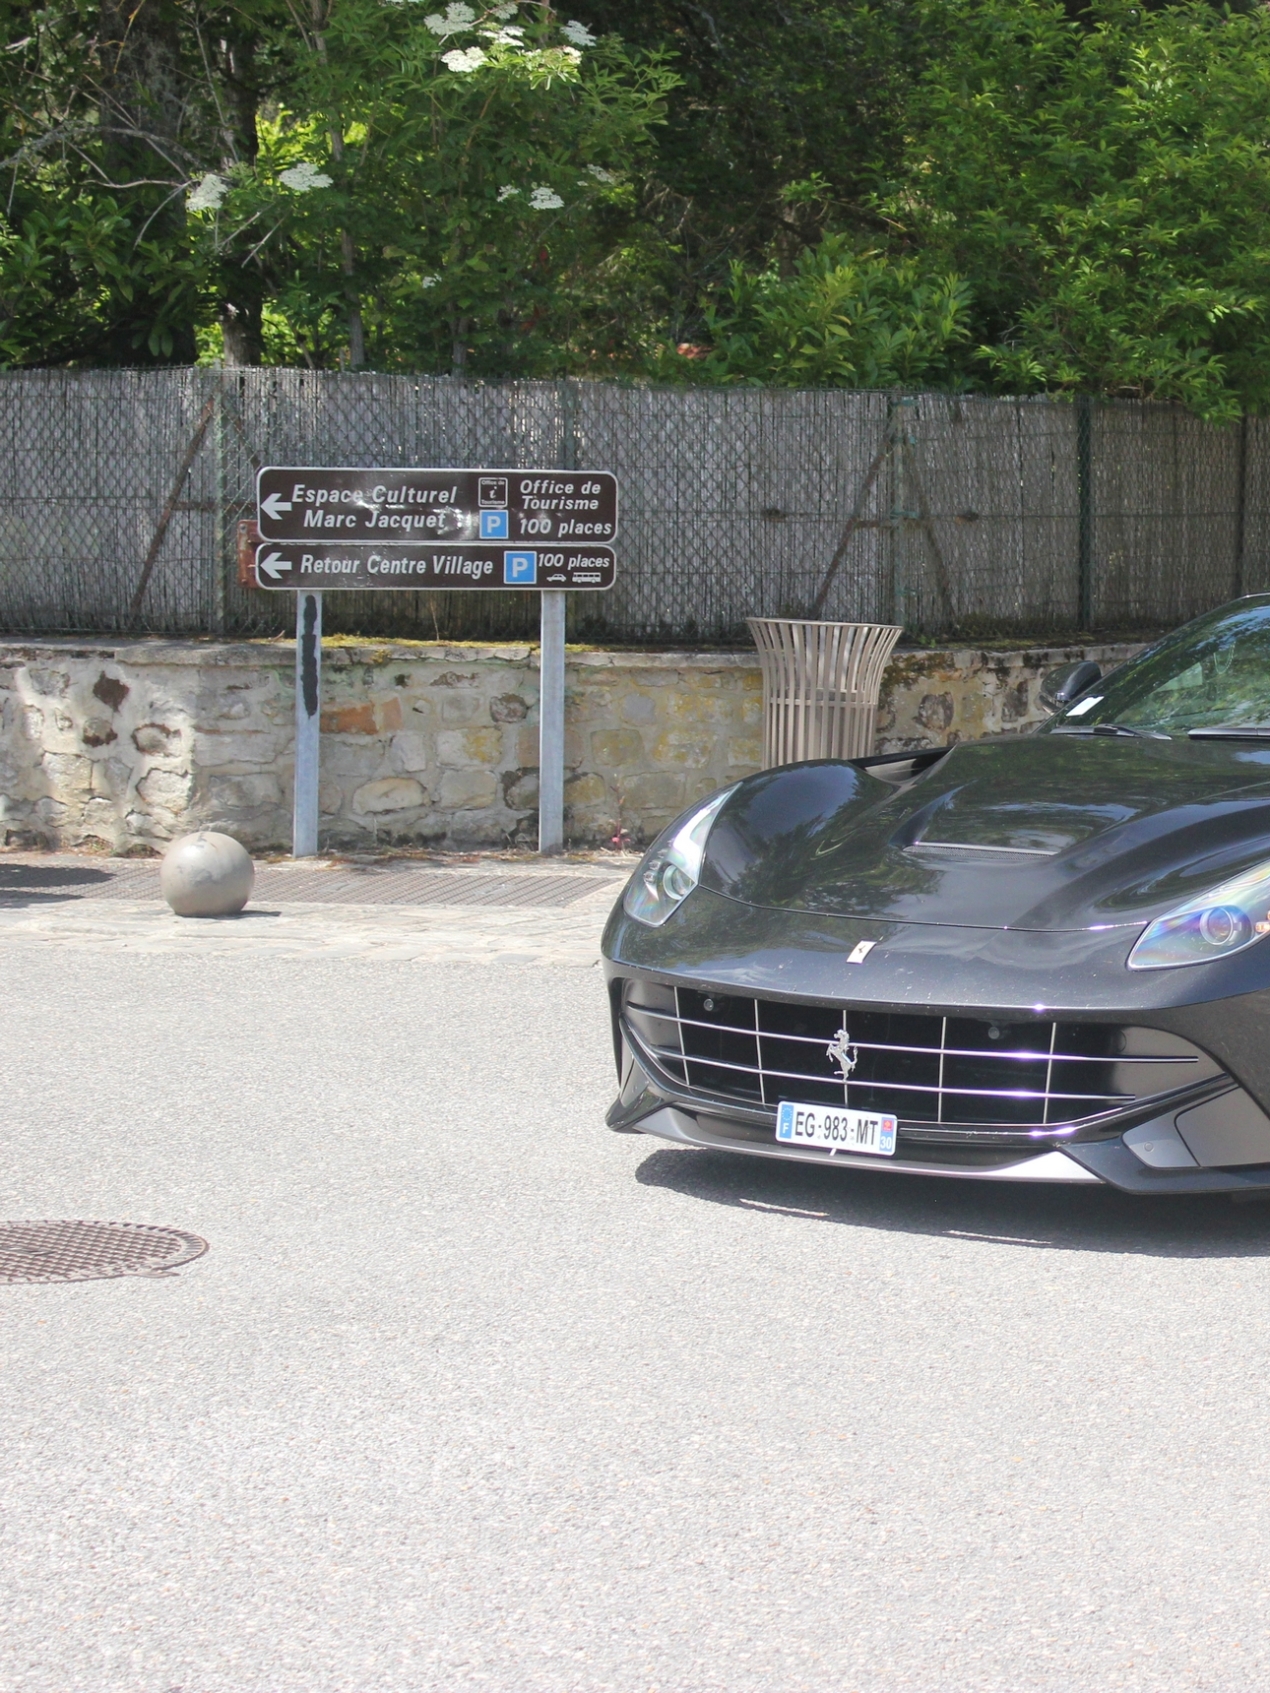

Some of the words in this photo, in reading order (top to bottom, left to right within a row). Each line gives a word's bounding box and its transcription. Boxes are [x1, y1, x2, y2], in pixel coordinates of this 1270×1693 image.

[291, 484, 364, 507] Espace
[372, 485, 458, 503] Culturel
[520, 480, 574, 494] Office
[581, 481, 601, 494] de
[521, 495, 599, 510] Tourisme
[303, 510, 357, 528] Marc
[365, 510, 447, 532] Jacquet
[487, 516, 501, 533] P
[520, 519, 552, 534] 100
[558, 519, 612, 538] places
[300, 554, 360, 574] Retour
[367, 555, 426, 574] Centre
[432, 555, 493, 579] Village
[512, 557, 528, 578] P
[538, 554, 564, 567] 100
[567, 554, 610, 570] places
[782, 1122, 790, 1134] F
[880, 1135, 892, 1150] 30
